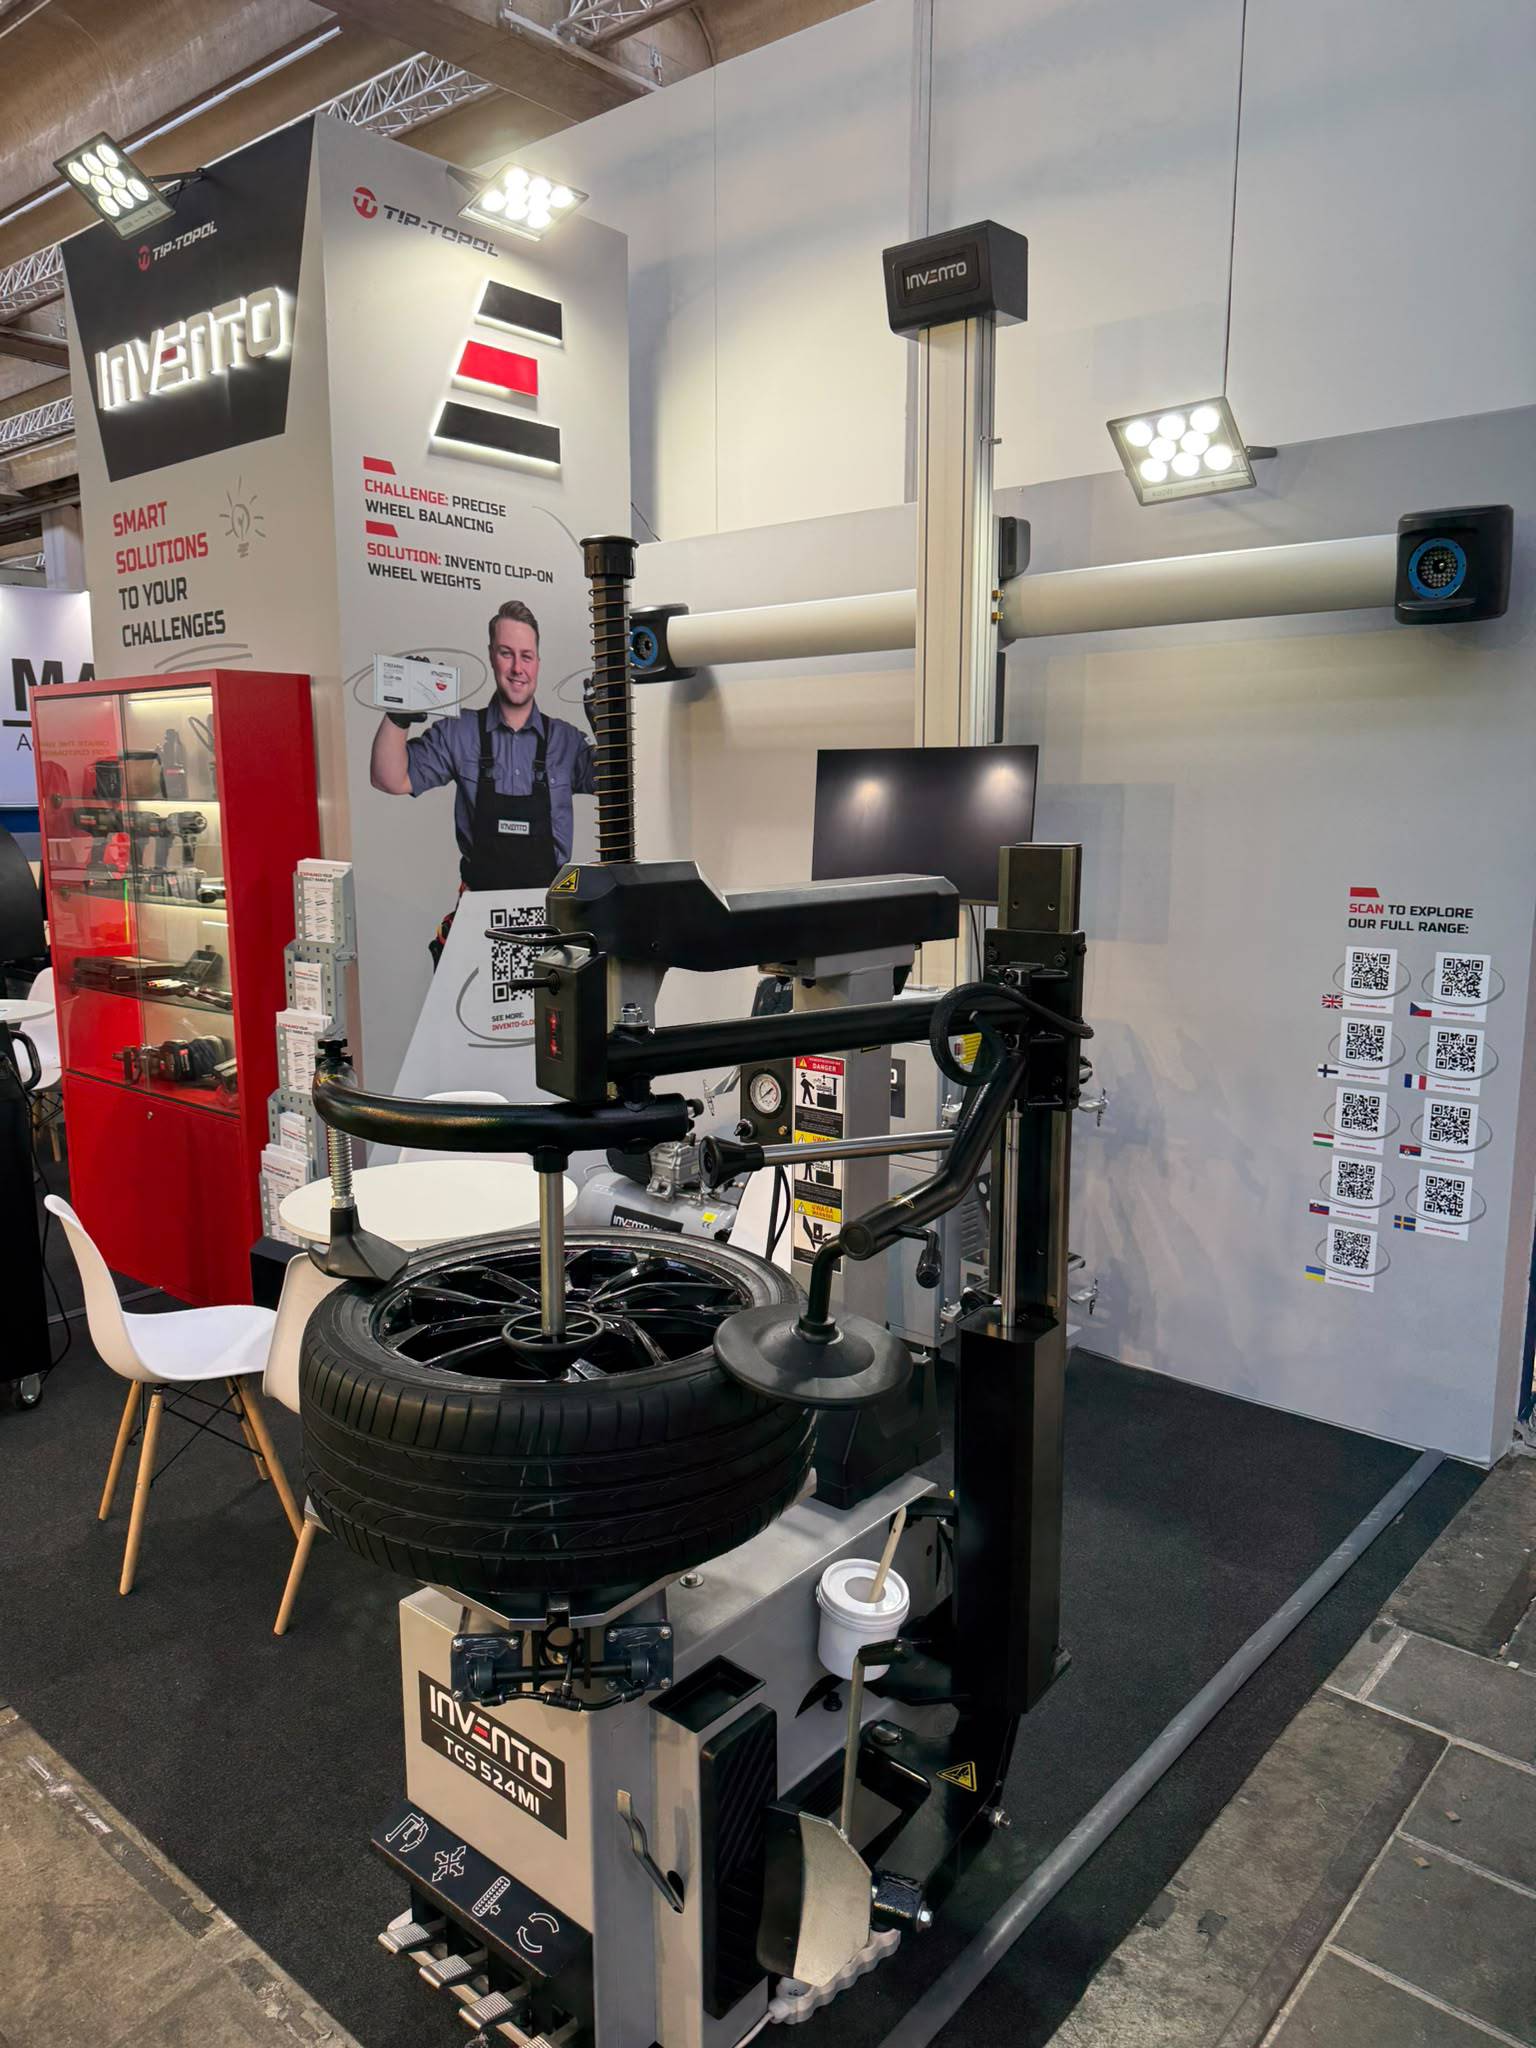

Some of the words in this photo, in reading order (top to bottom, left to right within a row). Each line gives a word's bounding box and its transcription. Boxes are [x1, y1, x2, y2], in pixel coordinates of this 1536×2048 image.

[152, 221, 218, 260] TIP-TOPOL
[383, 204, 499, 258] TIP-TOPOL
[906, 261, 968, 290] INVENTO
[95, 286, 289, 410] INVENTO
[364, 479, 449, 506] CHALLENGE:
[452, 495, 507, 517] PRECISE
[365, 498, 416, 520] WHEEL
[418, 508, 494, 534] BALANCING
[112, 500, 168, 537] SMART
[115, 532, 209, 574] SOLUTIONS
[367, 542, 442, 566] SOLUTION:
[444, 553, 502, 576] INVENTO
[504, 564, 554, 584] CLIP-ON
[118, 585, 139, 611] TO
[142, 576, 188, 606] YOUR
[367, 562, 418, 582] WHEEL
[420, 569, 482, 591] WEIGHTS
[122, 609, 226, 648] CHALLENGES
[1348, 918, 1376, 929] OUR
[1380, 920, 1414, 931] FULL
[1418, 922, 1469, 934] RANGE:
[1349, 903, 1384, 914] SCAN
[1388, 904, 1406, 916] TO
[1410, 906, 1474, 919] EXPLORE
[812, 1062, 837, 1072] DANGER
[429, 1684, 553, 1789] INVENTO
[444, 1735, 477, 1771] TCS
[480, 1762, 540, 1815] 524MI
